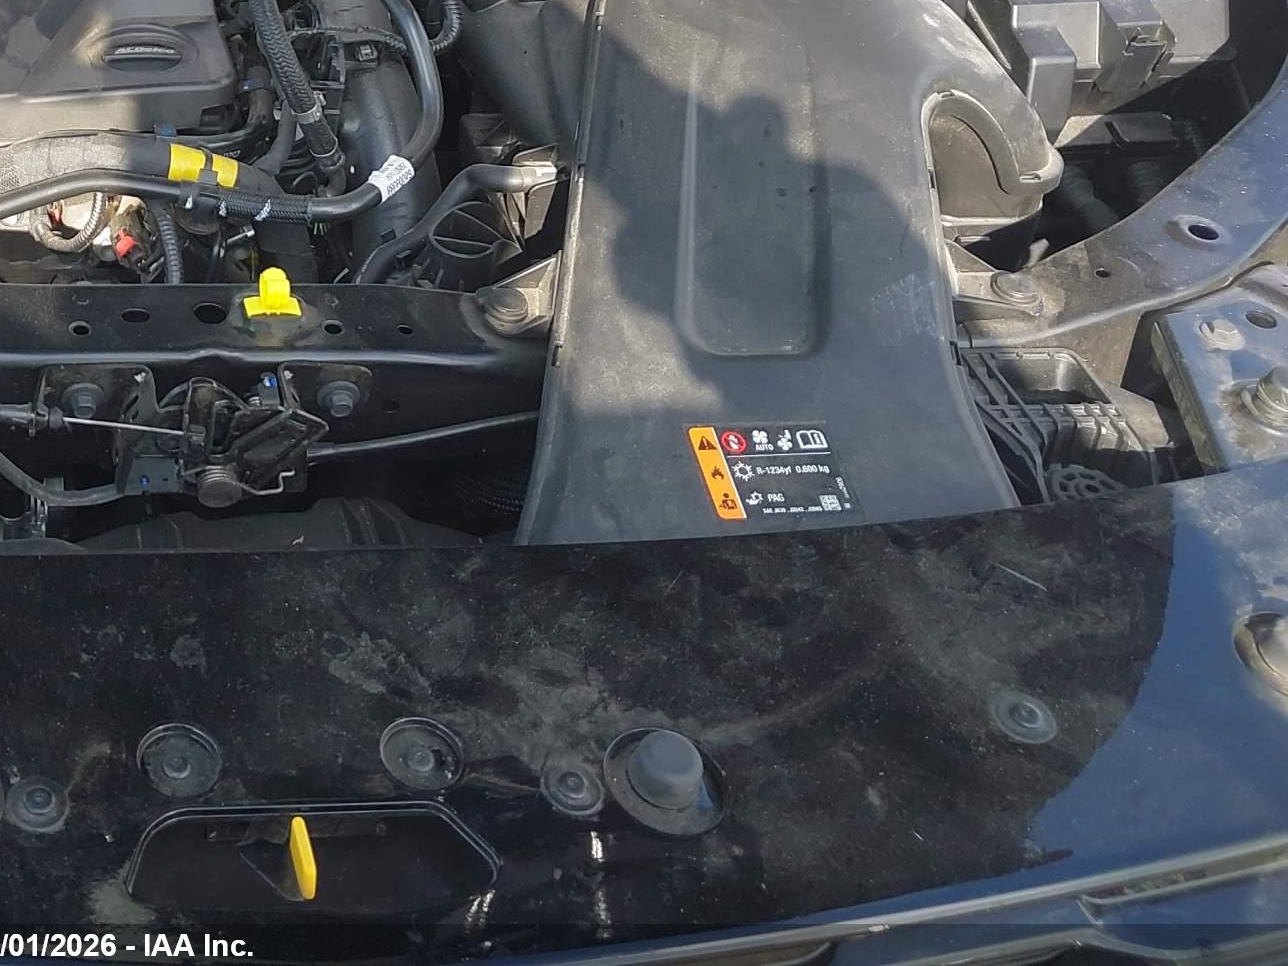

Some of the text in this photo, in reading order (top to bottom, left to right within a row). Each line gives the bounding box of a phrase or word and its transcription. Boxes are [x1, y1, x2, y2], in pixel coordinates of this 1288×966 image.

[755, 443, 774, 451] AUTO
[756, 464, 830, 476] R-1234yf 0.600 kg
[767, 493, 785, 503] PAG
